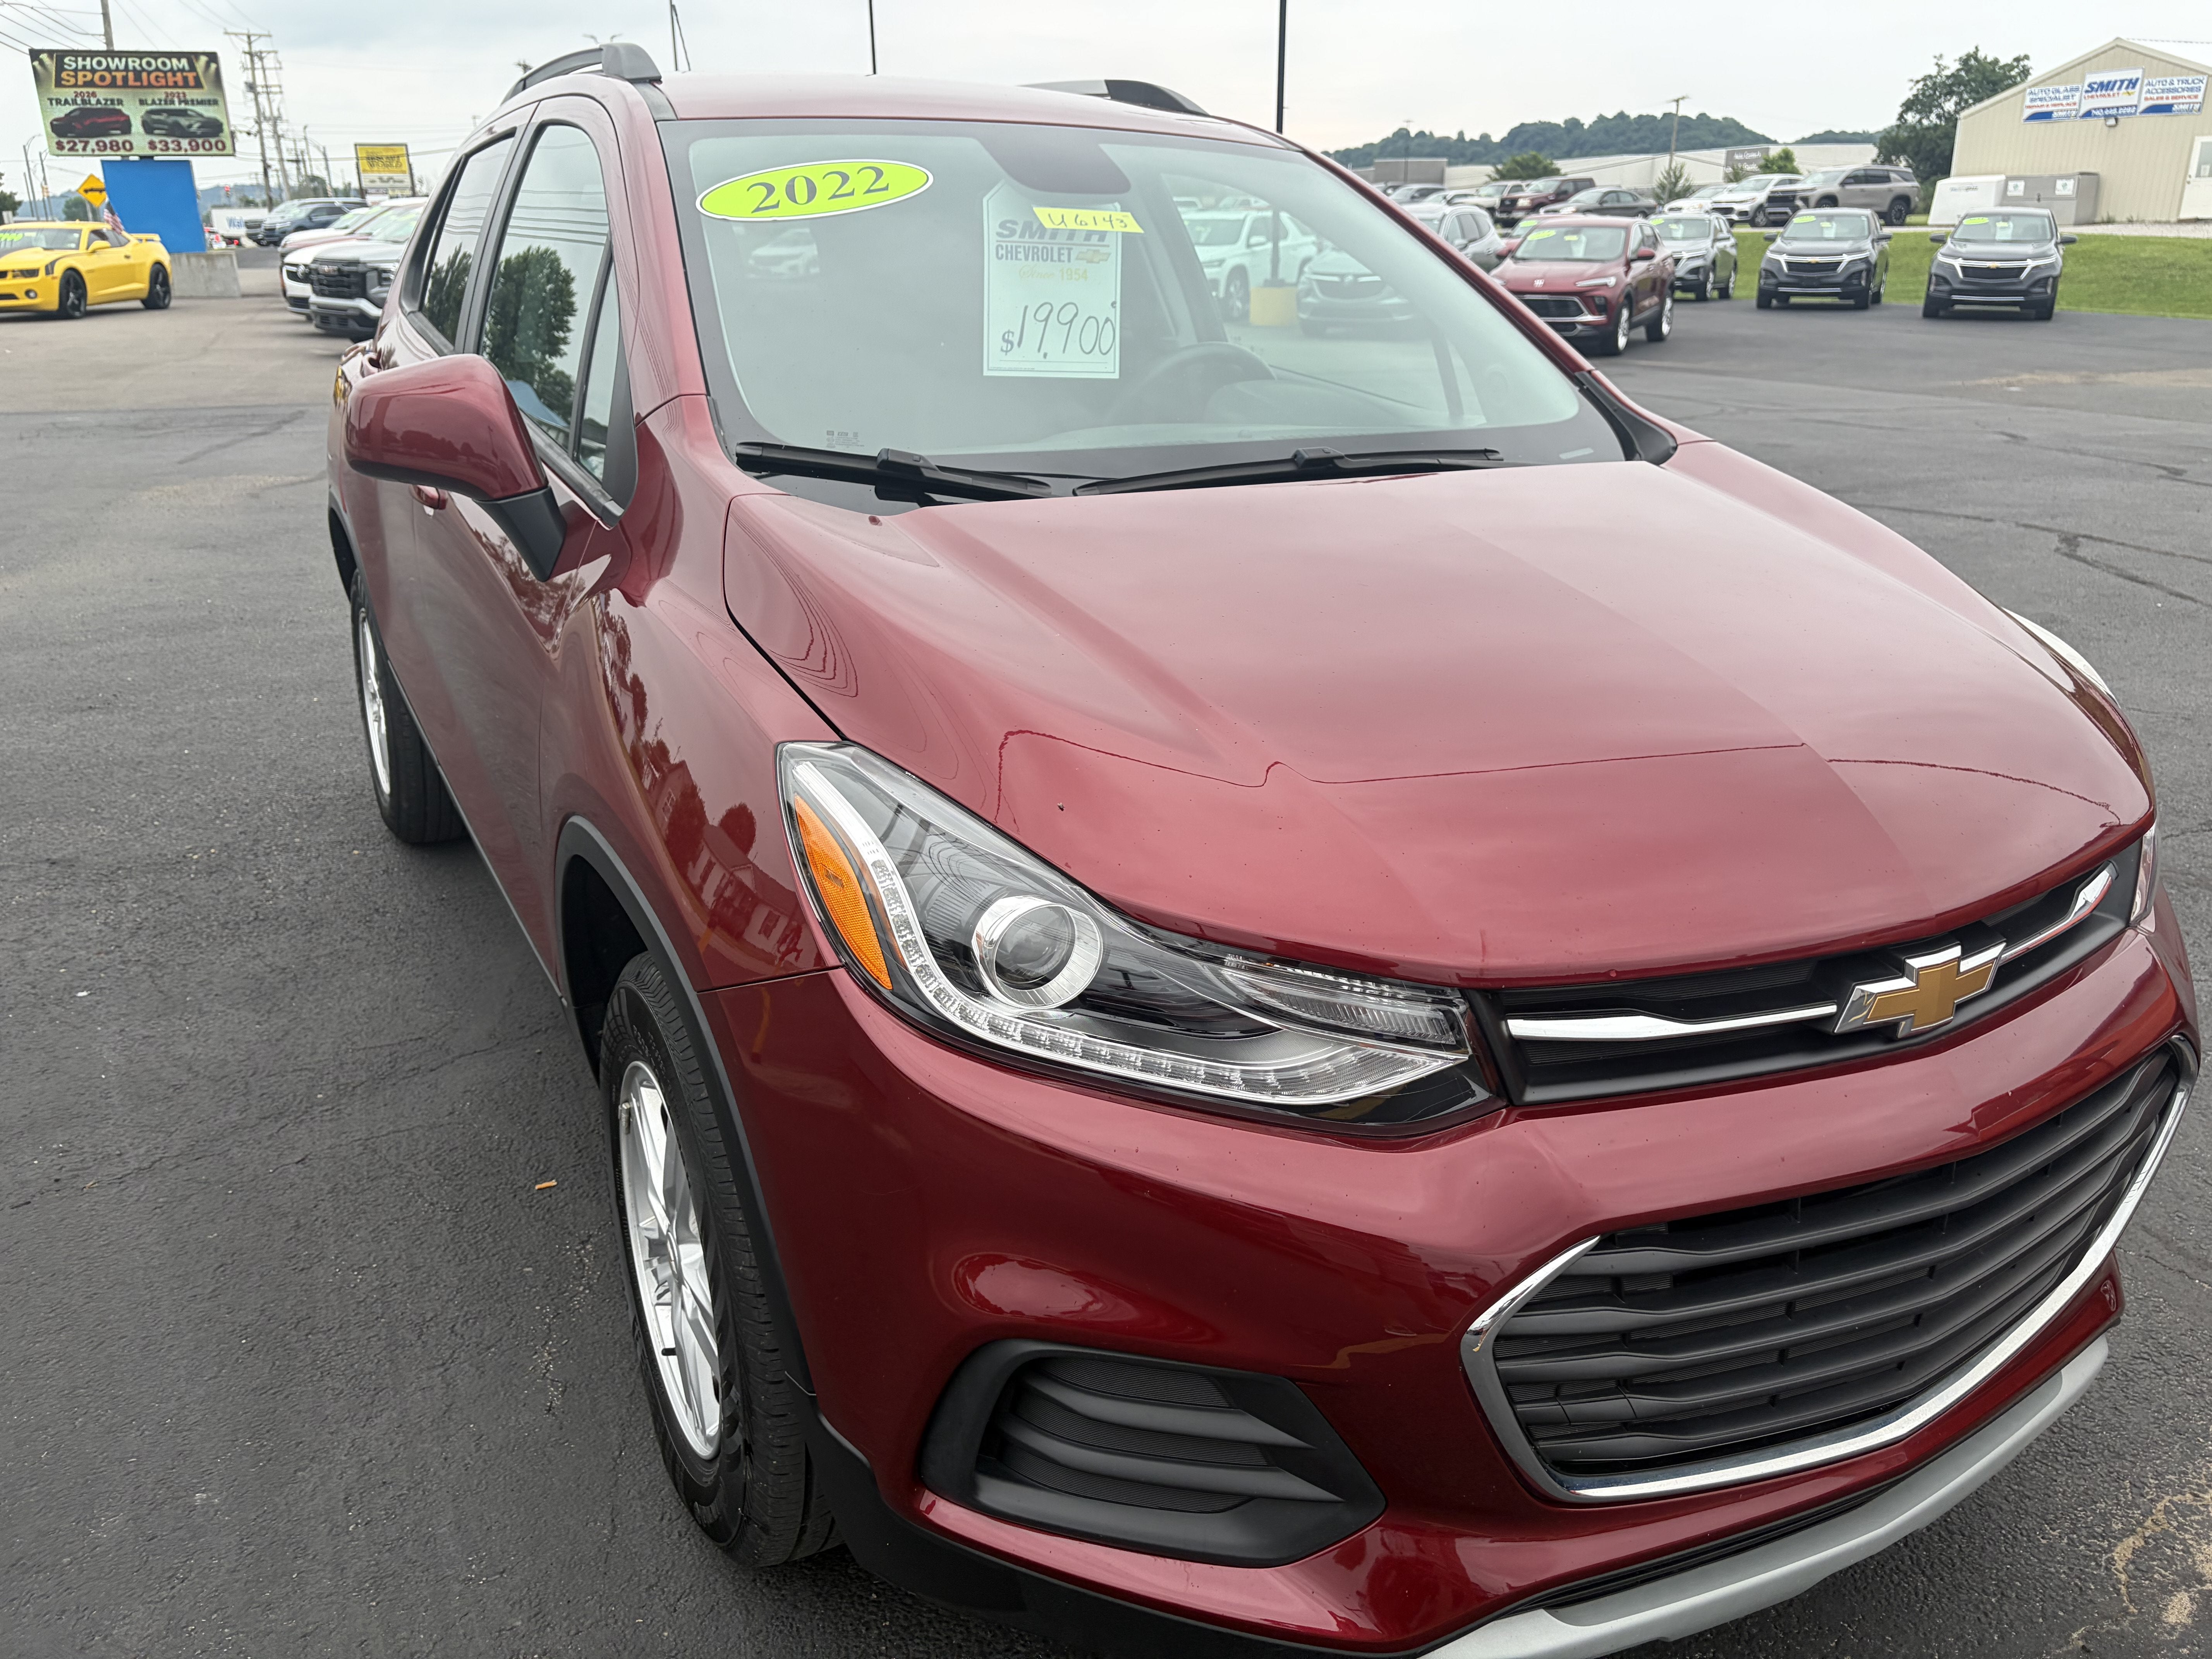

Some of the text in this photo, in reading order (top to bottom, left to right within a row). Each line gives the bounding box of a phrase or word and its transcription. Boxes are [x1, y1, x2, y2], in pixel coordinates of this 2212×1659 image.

[64, 56, 190, 71] SHOWROOM
[61, 70, 197, 87] SPOTLIGHT
[2084, 76, 2140, 93] SMITH
[47, 98, 123, 106] TRAILBLAZER
[55, 139, 133, 154] $27,980
[148, 139, 226, 153] $33,900
[746, 166, 889, 214] 2022
[995, 244, 1073, 263] CHEVROLET
[1060, 267, 1089, 282] 1954
